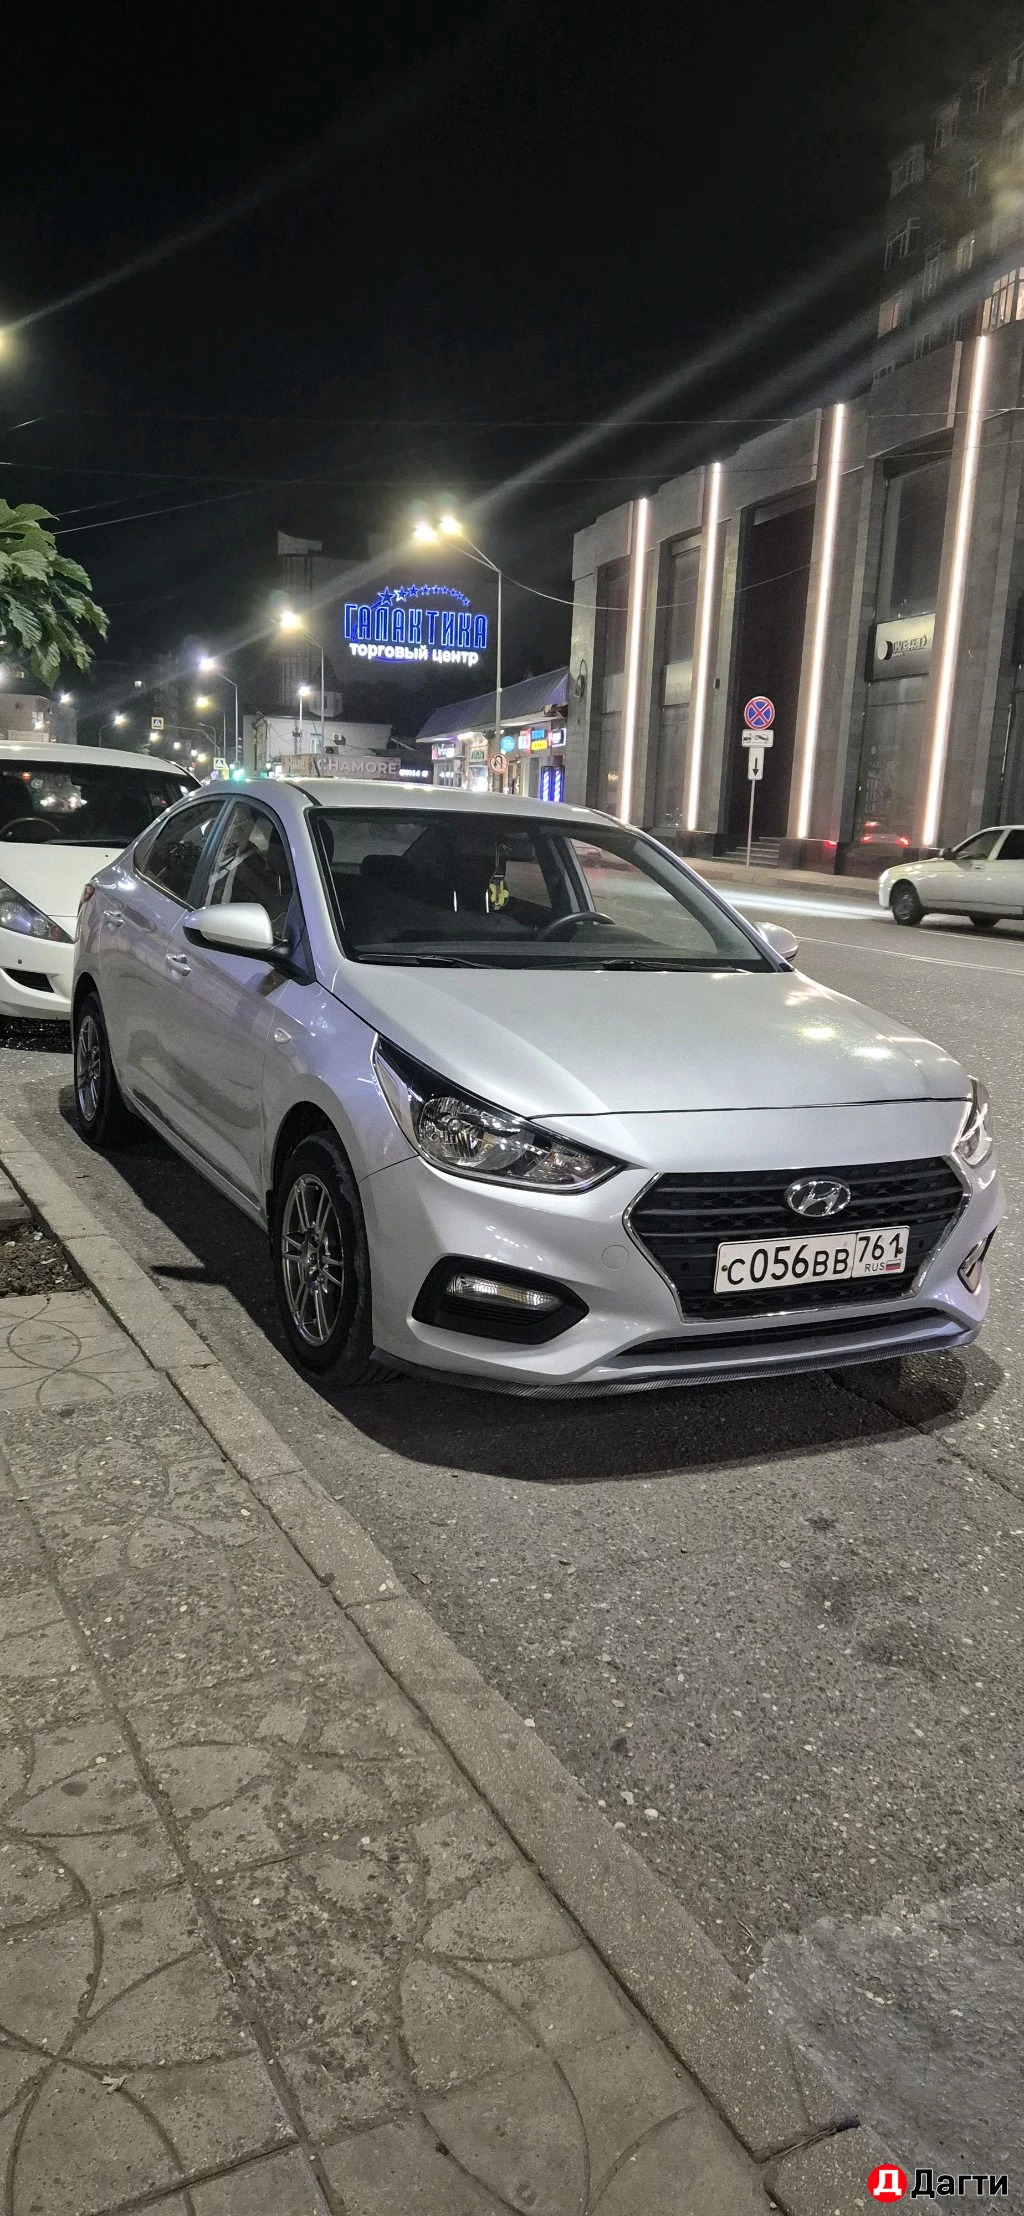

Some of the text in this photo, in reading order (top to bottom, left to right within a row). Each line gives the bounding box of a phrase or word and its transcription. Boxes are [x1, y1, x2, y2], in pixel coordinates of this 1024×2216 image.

[344, 603, 488, 650] ГАЛАКТИКА
[349, 642, 480, 668] торговый центр
[858, 1233, 901, 1263] 761
[864, 1262, 885, 1273] RUS
